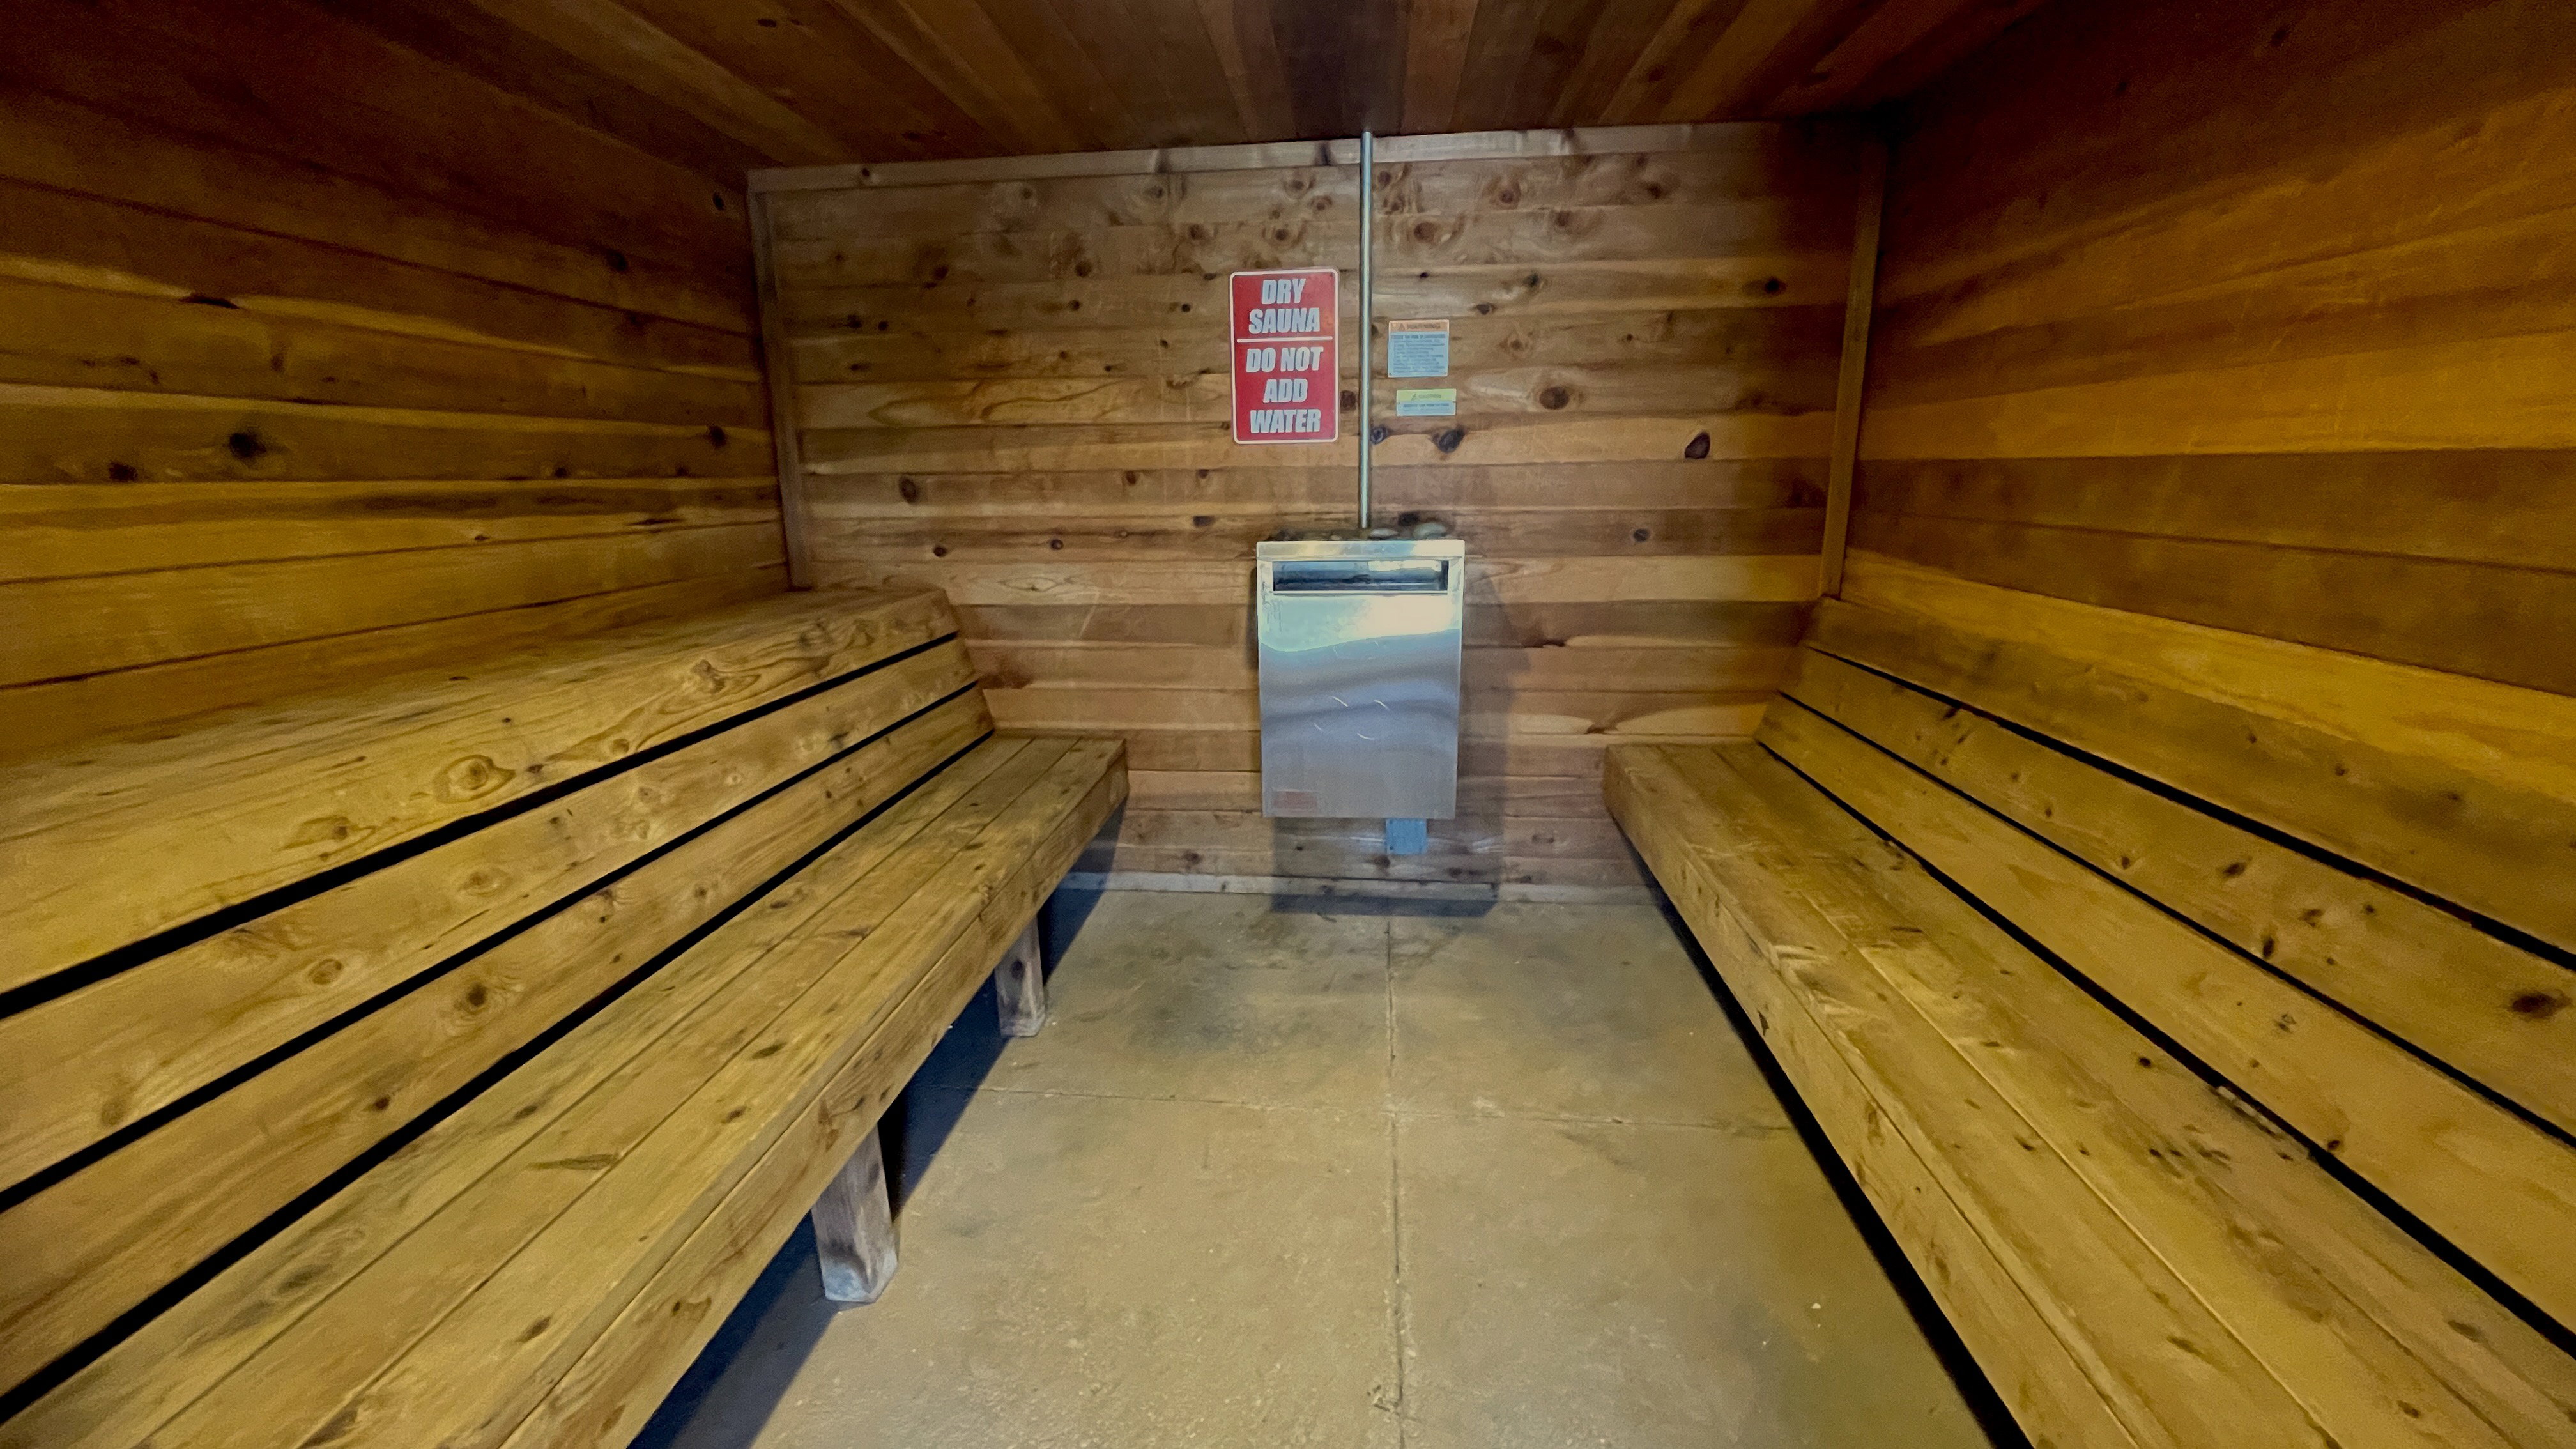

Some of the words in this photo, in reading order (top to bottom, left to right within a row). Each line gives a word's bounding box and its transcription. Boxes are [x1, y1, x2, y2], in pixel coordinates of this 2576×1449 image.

[1261, 279, 1306, 305] DRY
[1248, 307, 1320, 334] SAUNA
[1246, 348, 1276, 372] DO
[1280, 346, 1324, 372] NOT
[1262, 378, 1308, 403] ADD
[1250, 409, 1321, 434] WATER
